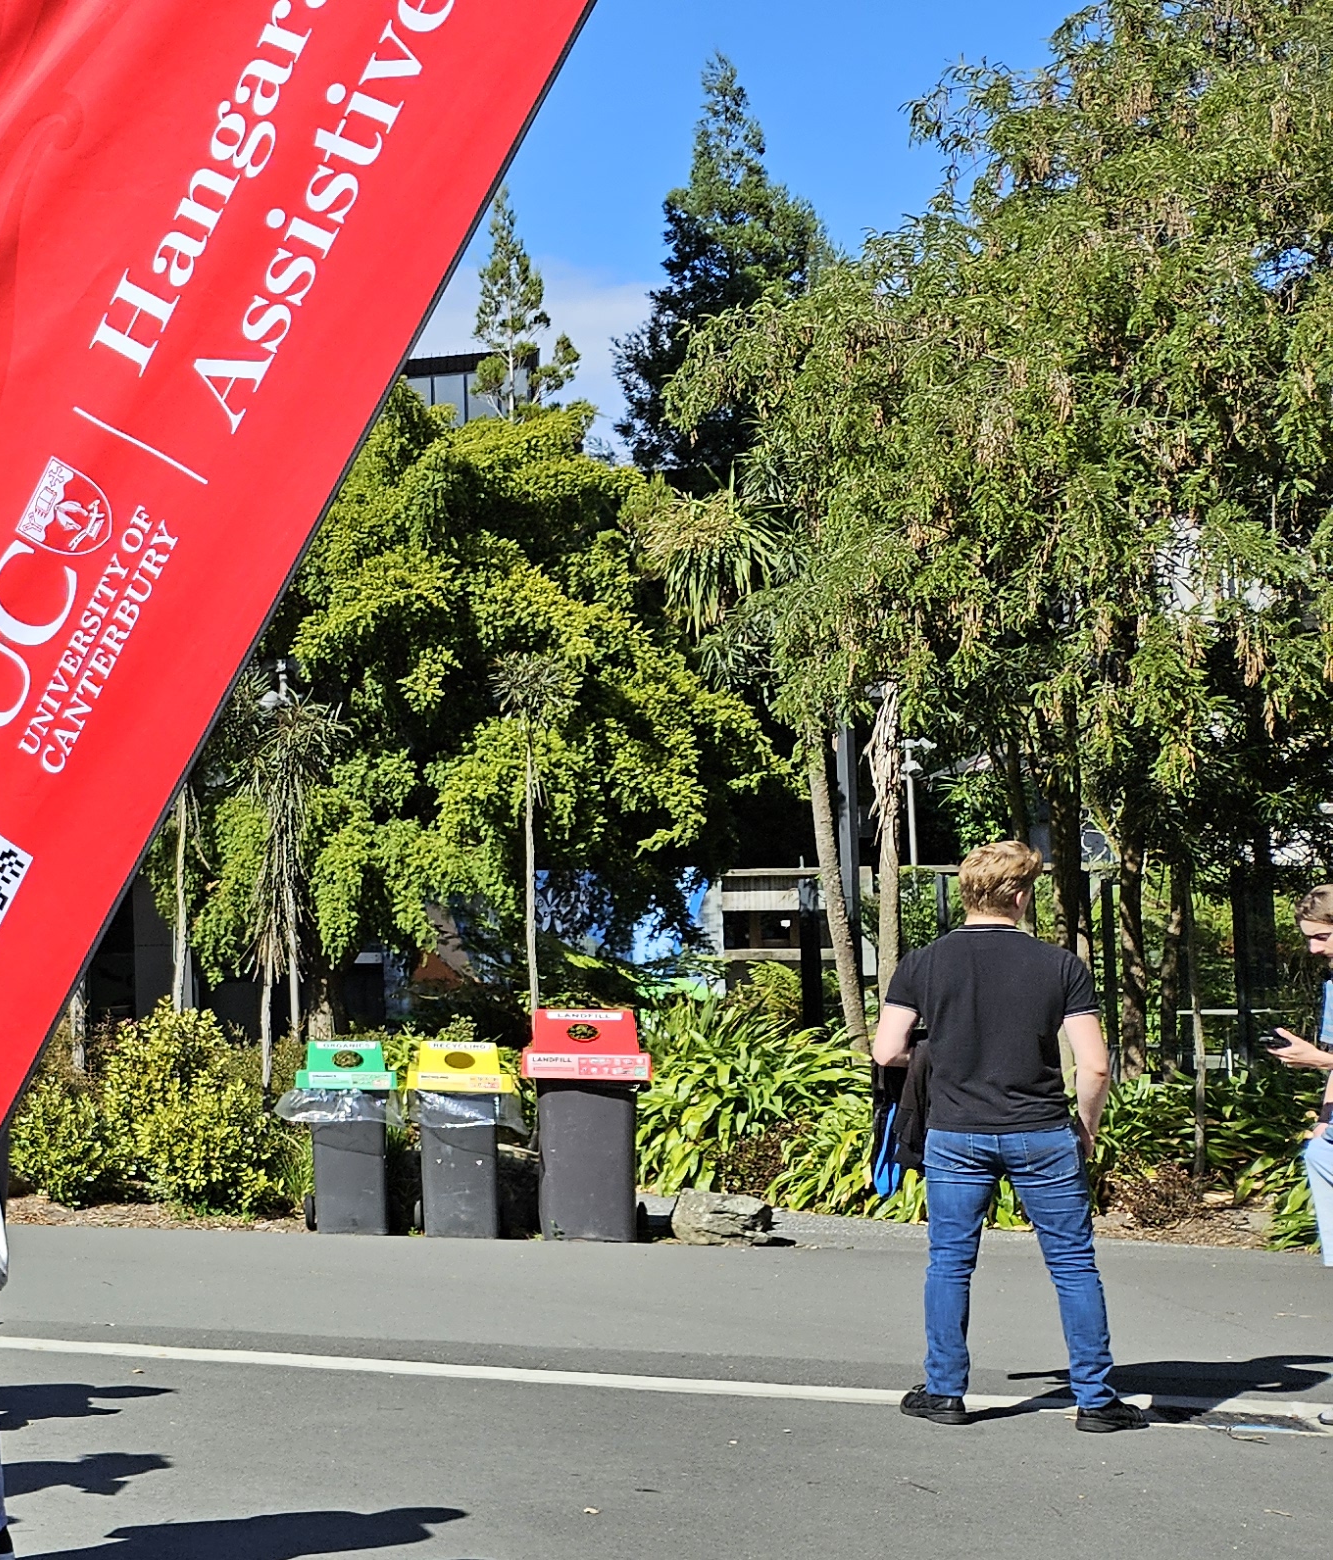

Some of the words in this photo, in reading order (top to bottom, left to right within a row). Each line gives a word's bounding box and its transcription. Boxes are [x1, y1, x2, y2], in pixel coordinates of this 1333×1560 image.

[89, 0, 326, 377] Hangar
[195, 0, 454, 434] Assistive
[18, 554, 130, 756] UNIVERSITY
[122, 505, 153, 553] OF
[42, 519, 179, 774] CANTERBURY
[433, 1042, 487, 1050] RECYCLING
